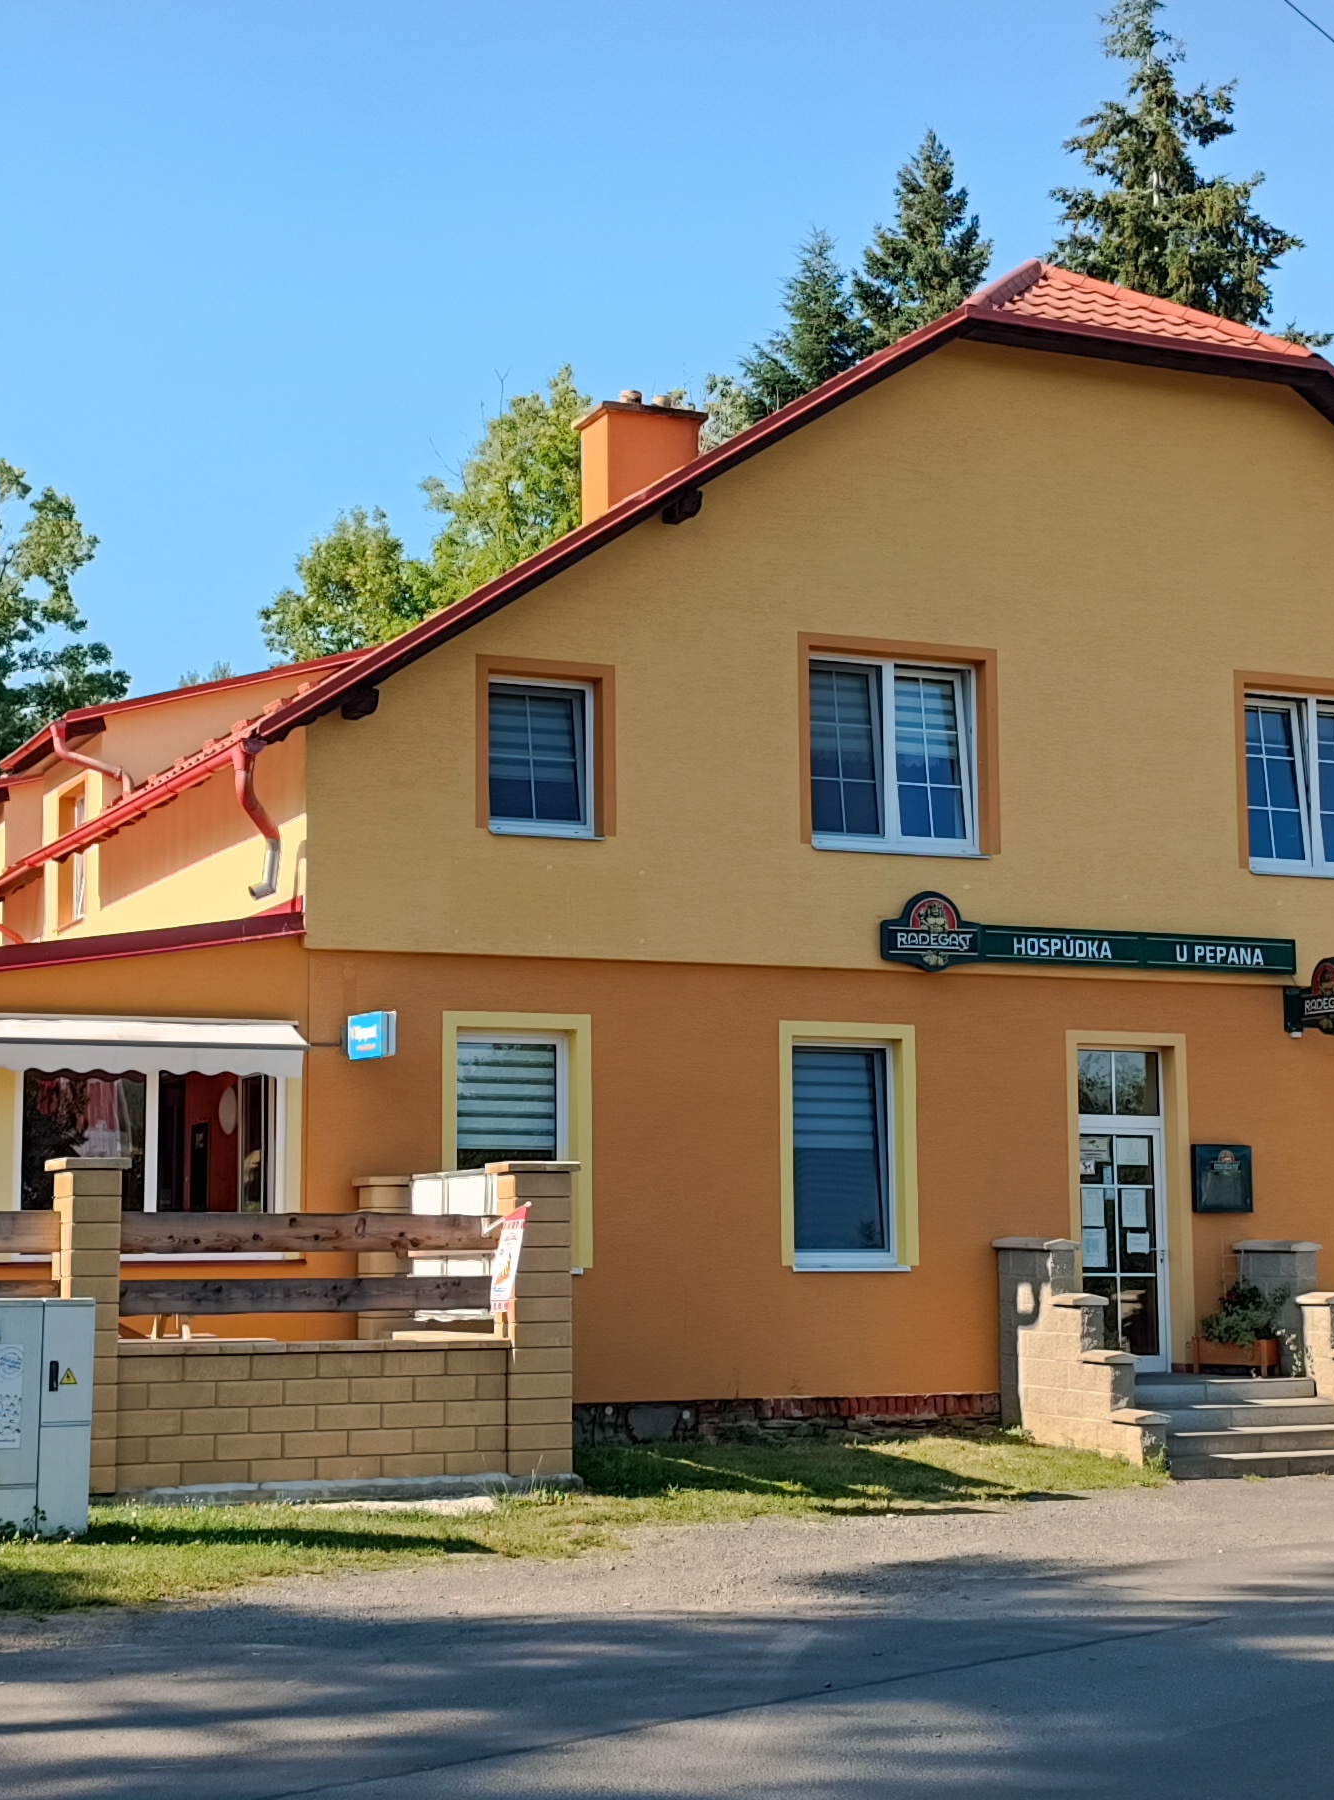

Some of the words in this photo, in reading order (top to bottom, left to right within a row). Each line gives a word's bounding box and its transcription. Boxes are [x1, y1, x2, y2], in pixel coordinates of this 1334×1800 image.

[897, 932, 973, 951] RADEGAST
[1012, 935, 1113, 960] HOSPŮDKA
[1175, 944, 1187, 963] U
[1194, 945, 1265, 966] PEPANA
